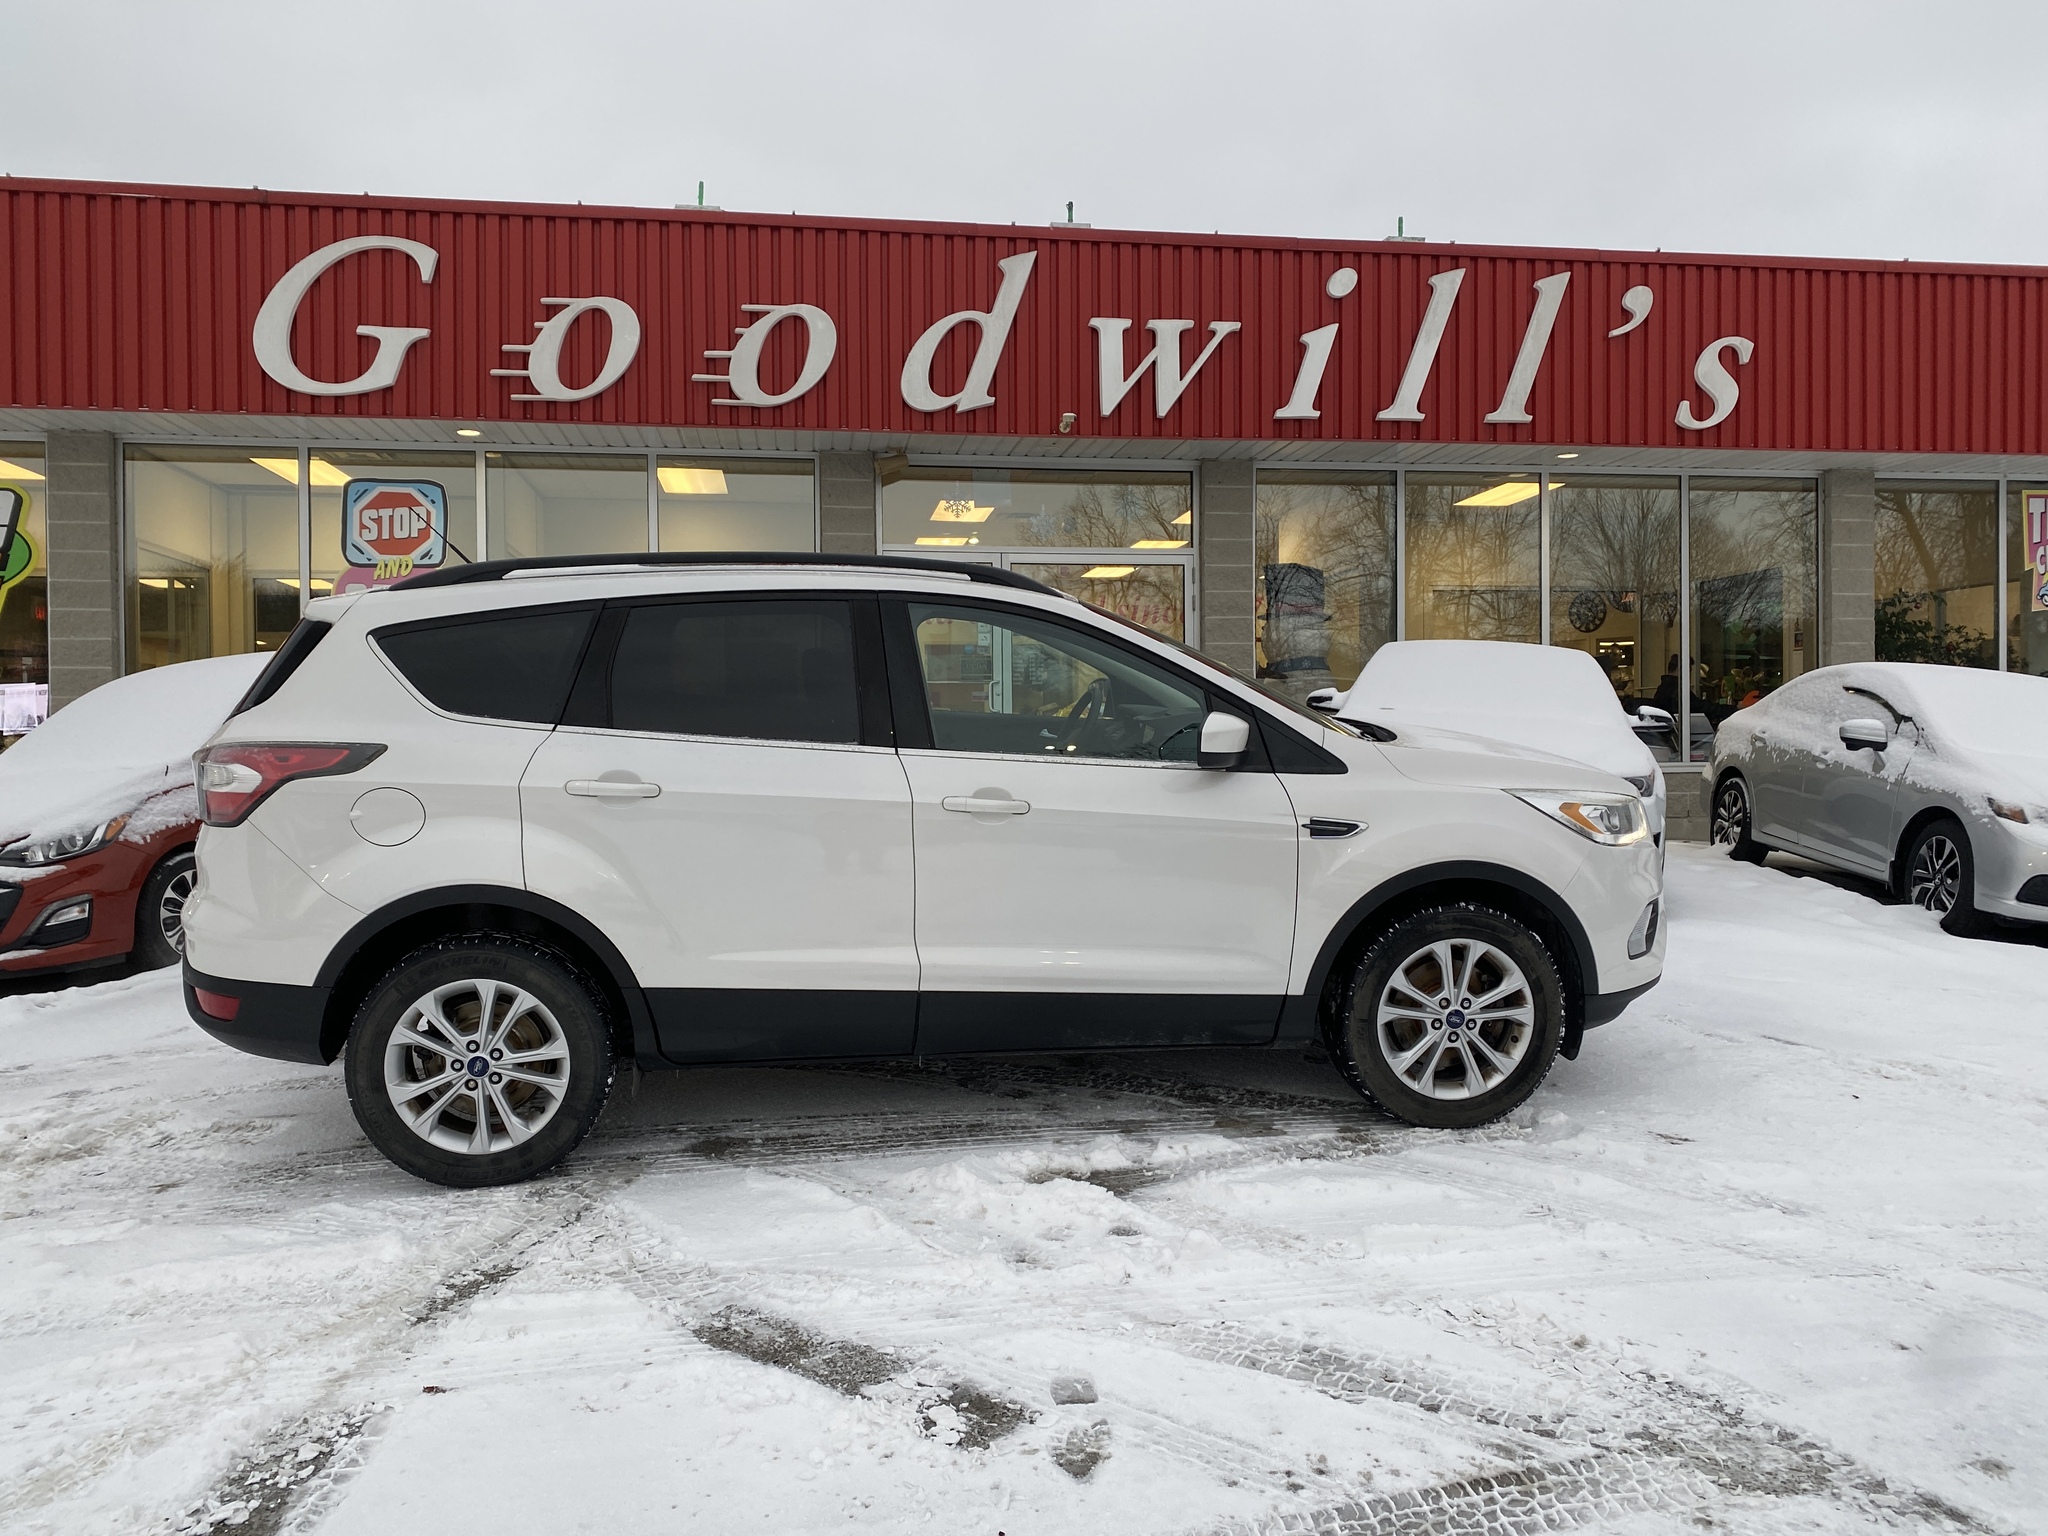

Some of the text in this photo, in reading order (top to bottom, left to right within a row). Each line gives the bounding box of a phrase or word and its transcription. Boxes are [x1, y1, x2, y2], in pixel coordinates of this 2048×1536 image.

[252, 235, 1755, 431] Goodwill's
[361, 506, 427, 541] STOP
[2028, 497, 2048, 543] T
[374, 557, 414, 580] AND
